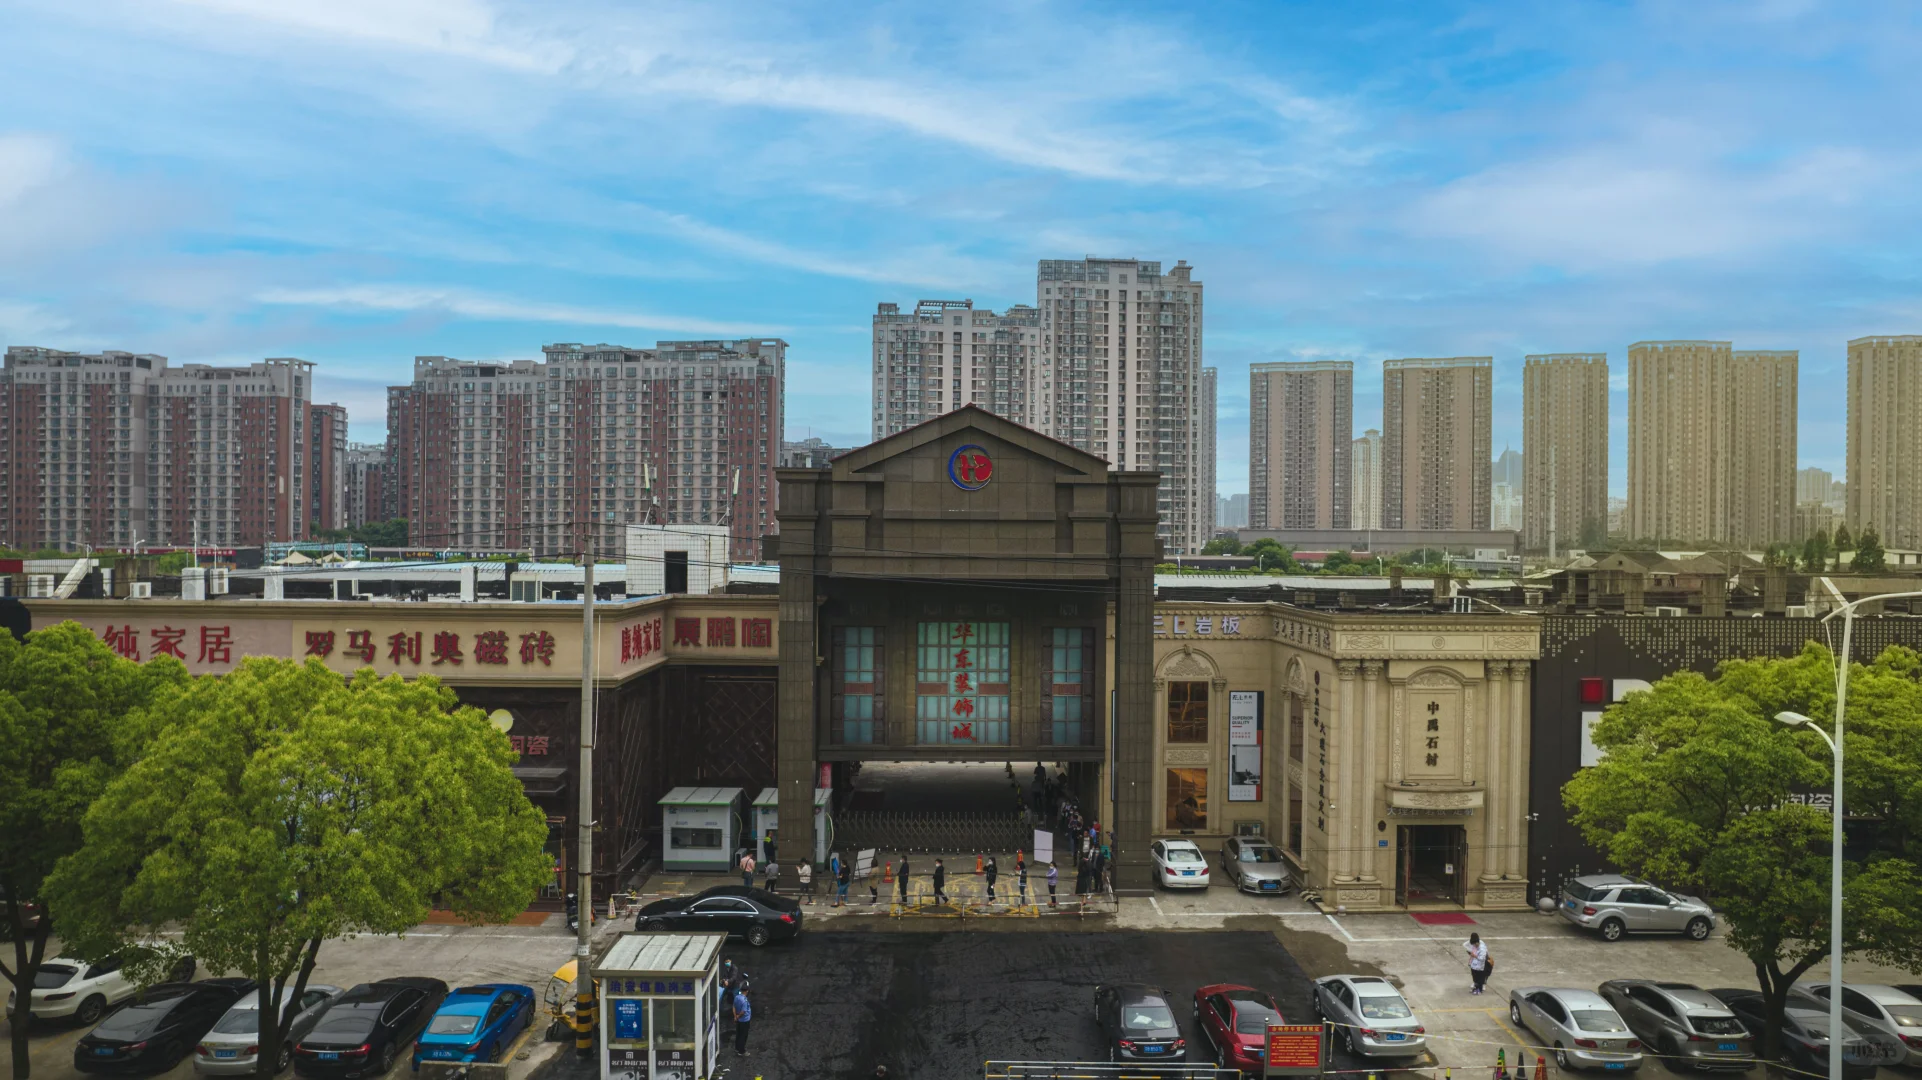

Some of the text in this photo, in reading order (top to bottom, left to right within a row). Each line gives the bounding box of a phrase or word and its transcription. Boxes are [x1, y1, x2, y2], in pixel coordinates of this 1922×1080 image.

[90, 625, 234, 663] 纯家居
[304, 630, 555, 666] 罗马利奥磁砖
[621, 618, 661, 664] 康纯家居
[952, 623, 977, 742] 华东装饰城
